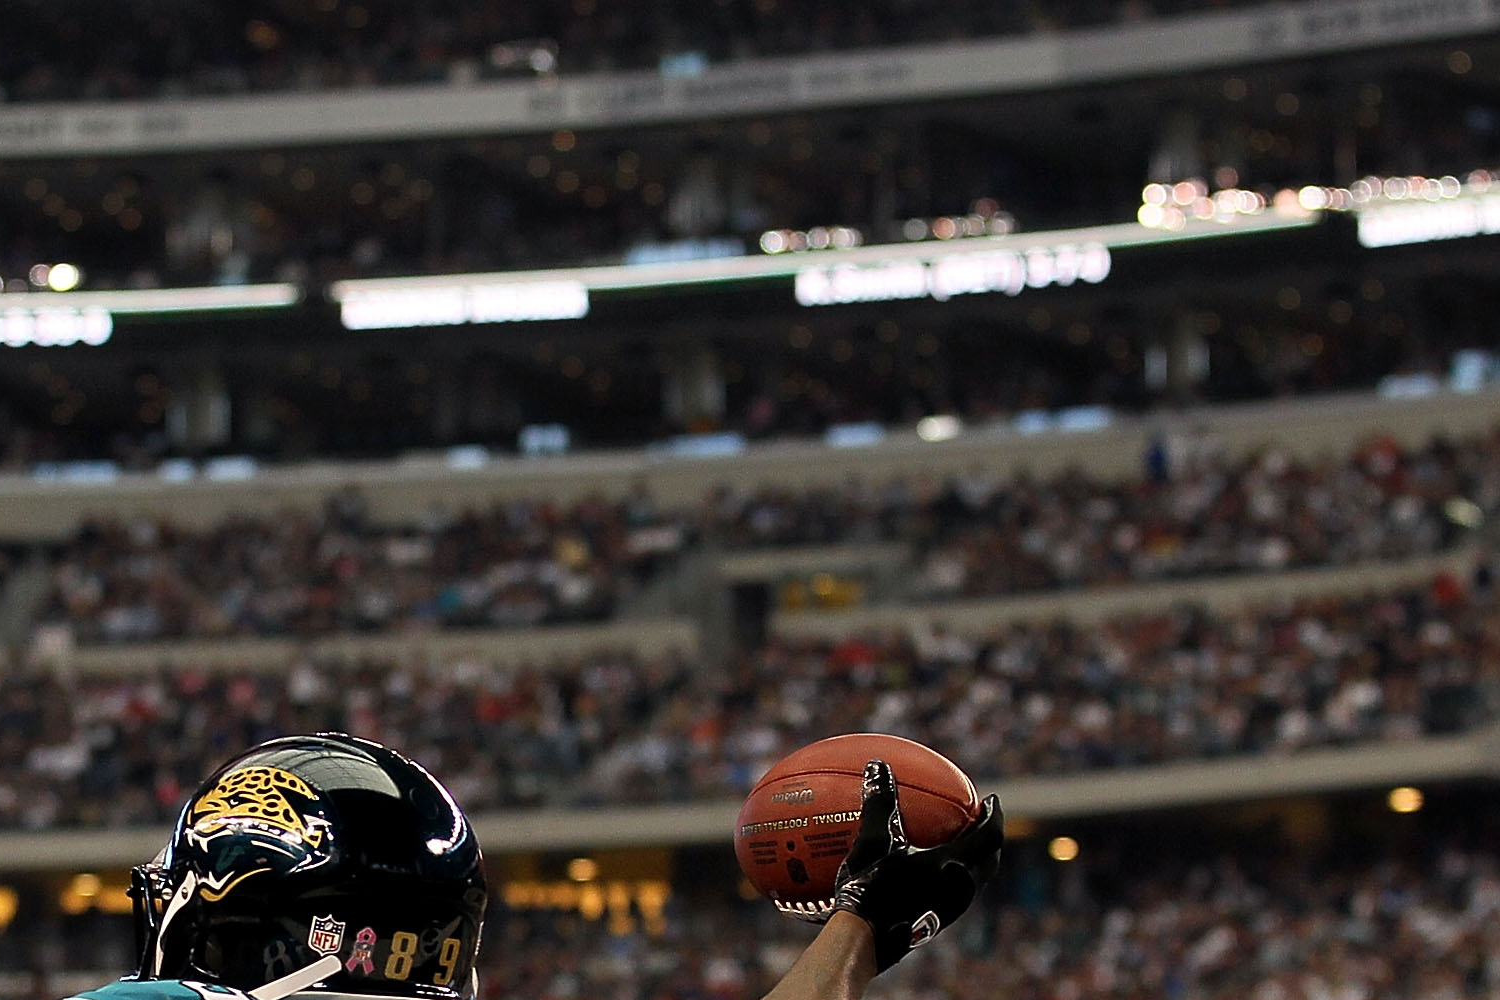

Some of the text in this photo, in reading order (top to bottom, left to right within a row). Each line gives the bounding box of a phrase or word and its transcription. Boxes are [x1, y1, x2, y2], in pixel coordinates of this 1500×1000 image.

[771, 788, 814, 805] Wilson
[763, 816, 809, 832] FOOTBALL
[812, 810, 862, 825] ATIONAL
[312, 931, 339, 950] NFL
